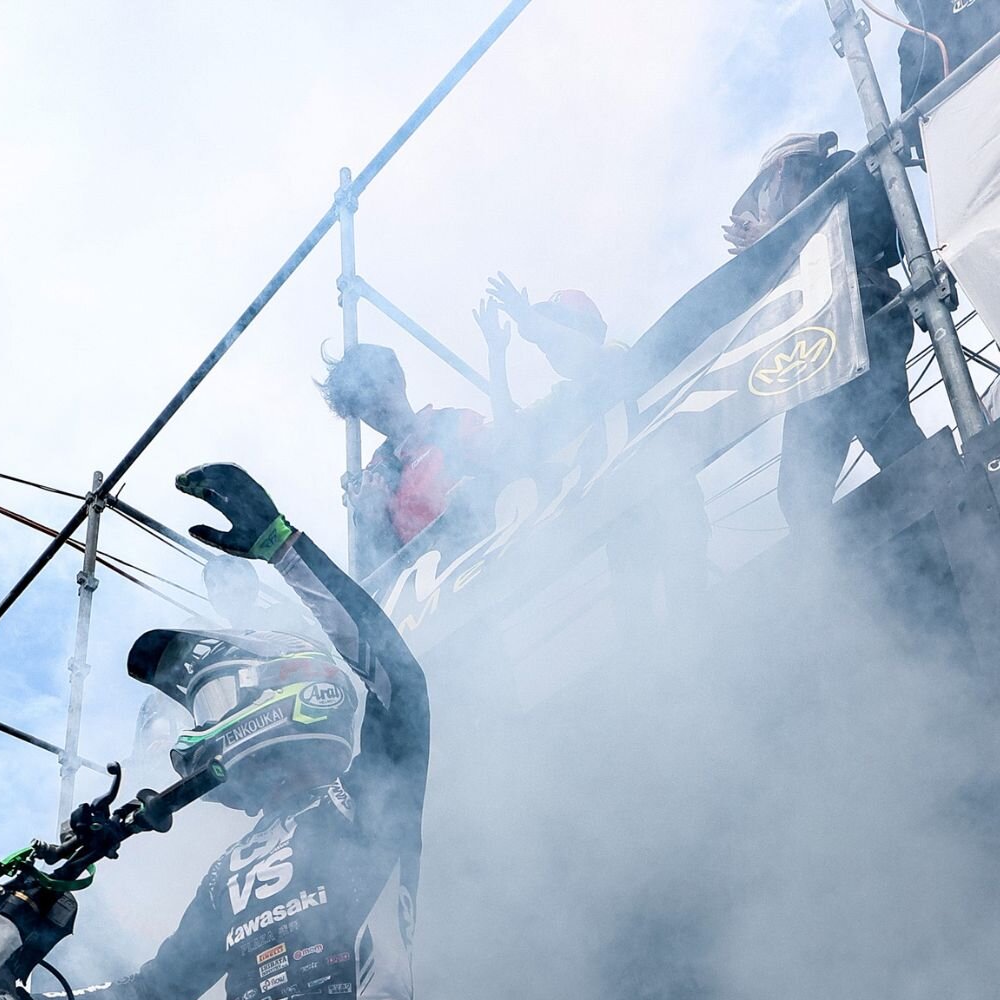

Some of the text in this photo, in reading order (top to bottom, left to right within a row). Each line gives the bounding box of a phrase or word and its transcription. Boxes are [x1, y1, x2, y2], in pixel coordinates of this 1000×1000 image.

[310, 686, 340, 701] Arai
[216, 708, 284, 754] ZENKOUKAI
[226, 885, 328, 951] Kawasaki
